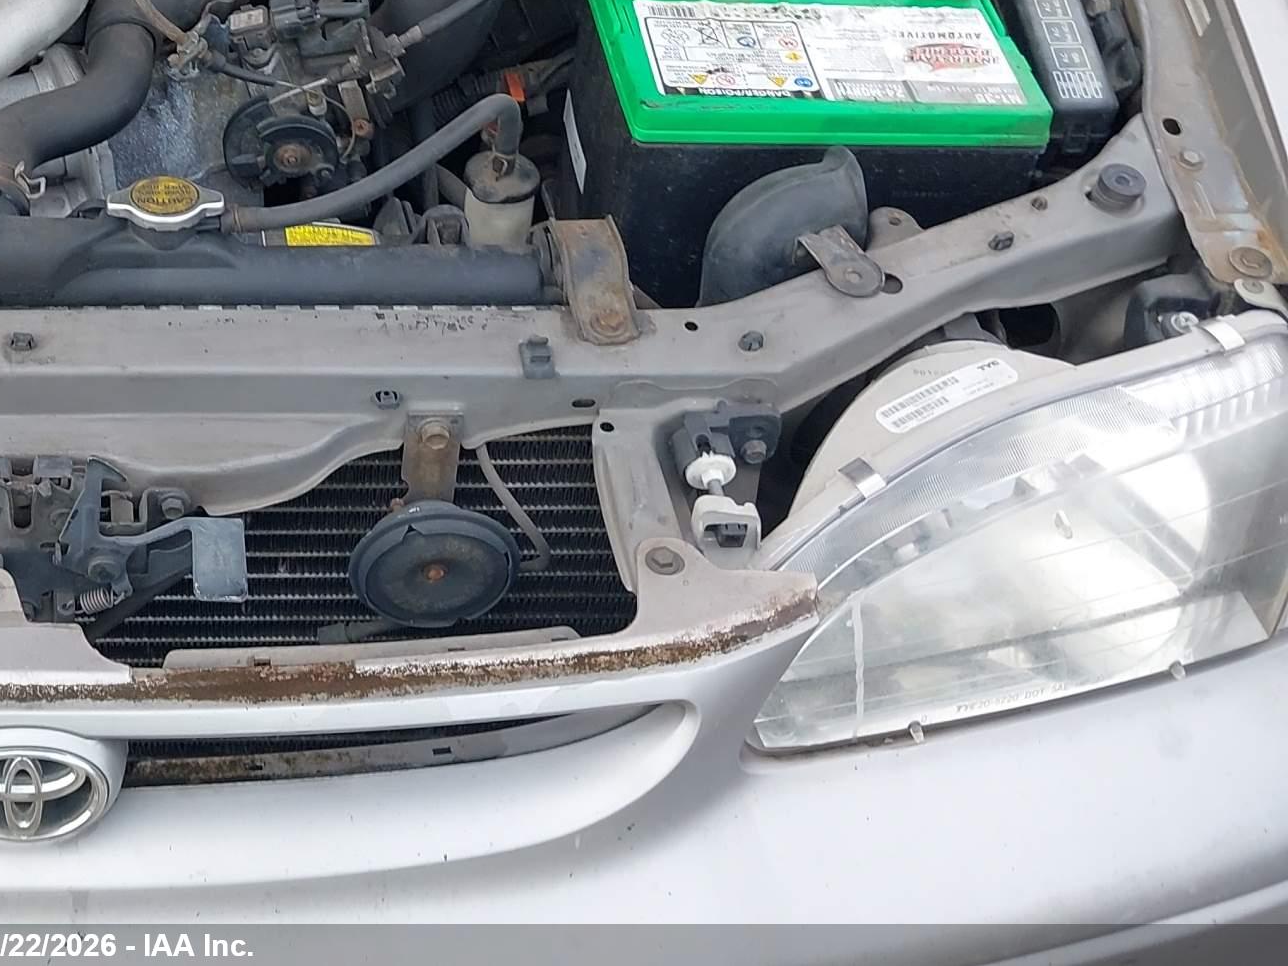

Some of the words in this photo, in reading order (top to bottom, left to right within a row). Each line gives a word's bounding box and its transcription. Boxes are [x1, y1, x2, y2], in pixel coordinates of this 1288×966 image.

[899, 31, 982, 40] AUTOMOTIVE
[698, 87, 791, 98] DANGER/POISON
[976, 360, 1000, 370] TYC
